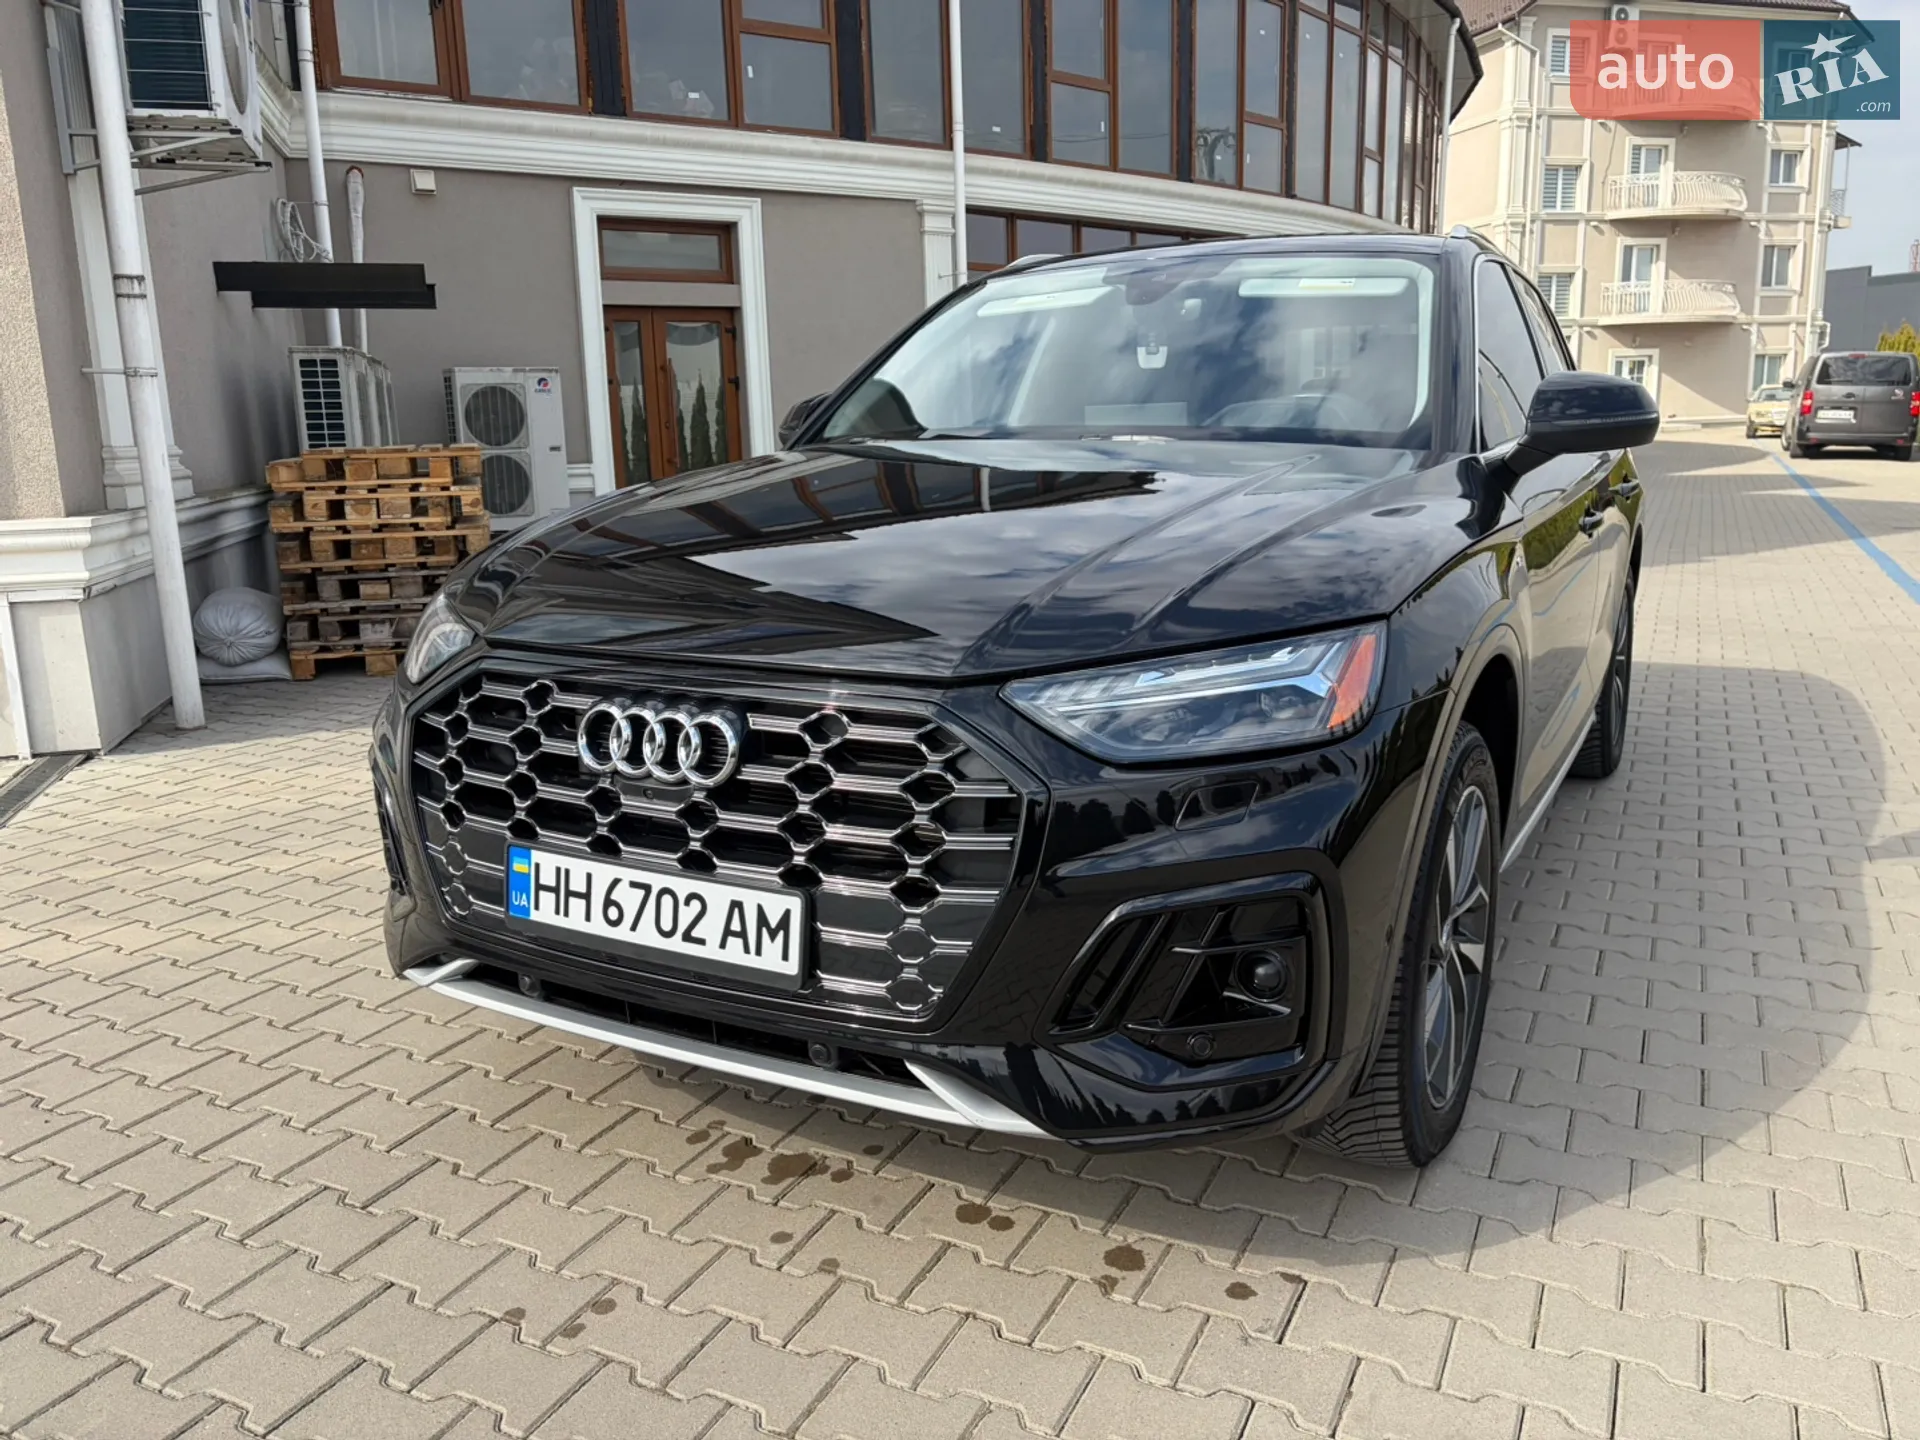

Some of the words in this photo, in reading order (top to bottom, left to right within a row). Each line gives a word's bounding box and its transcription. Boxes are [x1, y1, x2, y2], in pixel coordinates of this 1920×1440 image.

[512, 890, 529, 908] UA
[533, 861, 593, 923] HH
[602, 877, 708, 946] 6702
[718, 898, 792, 962] AM
